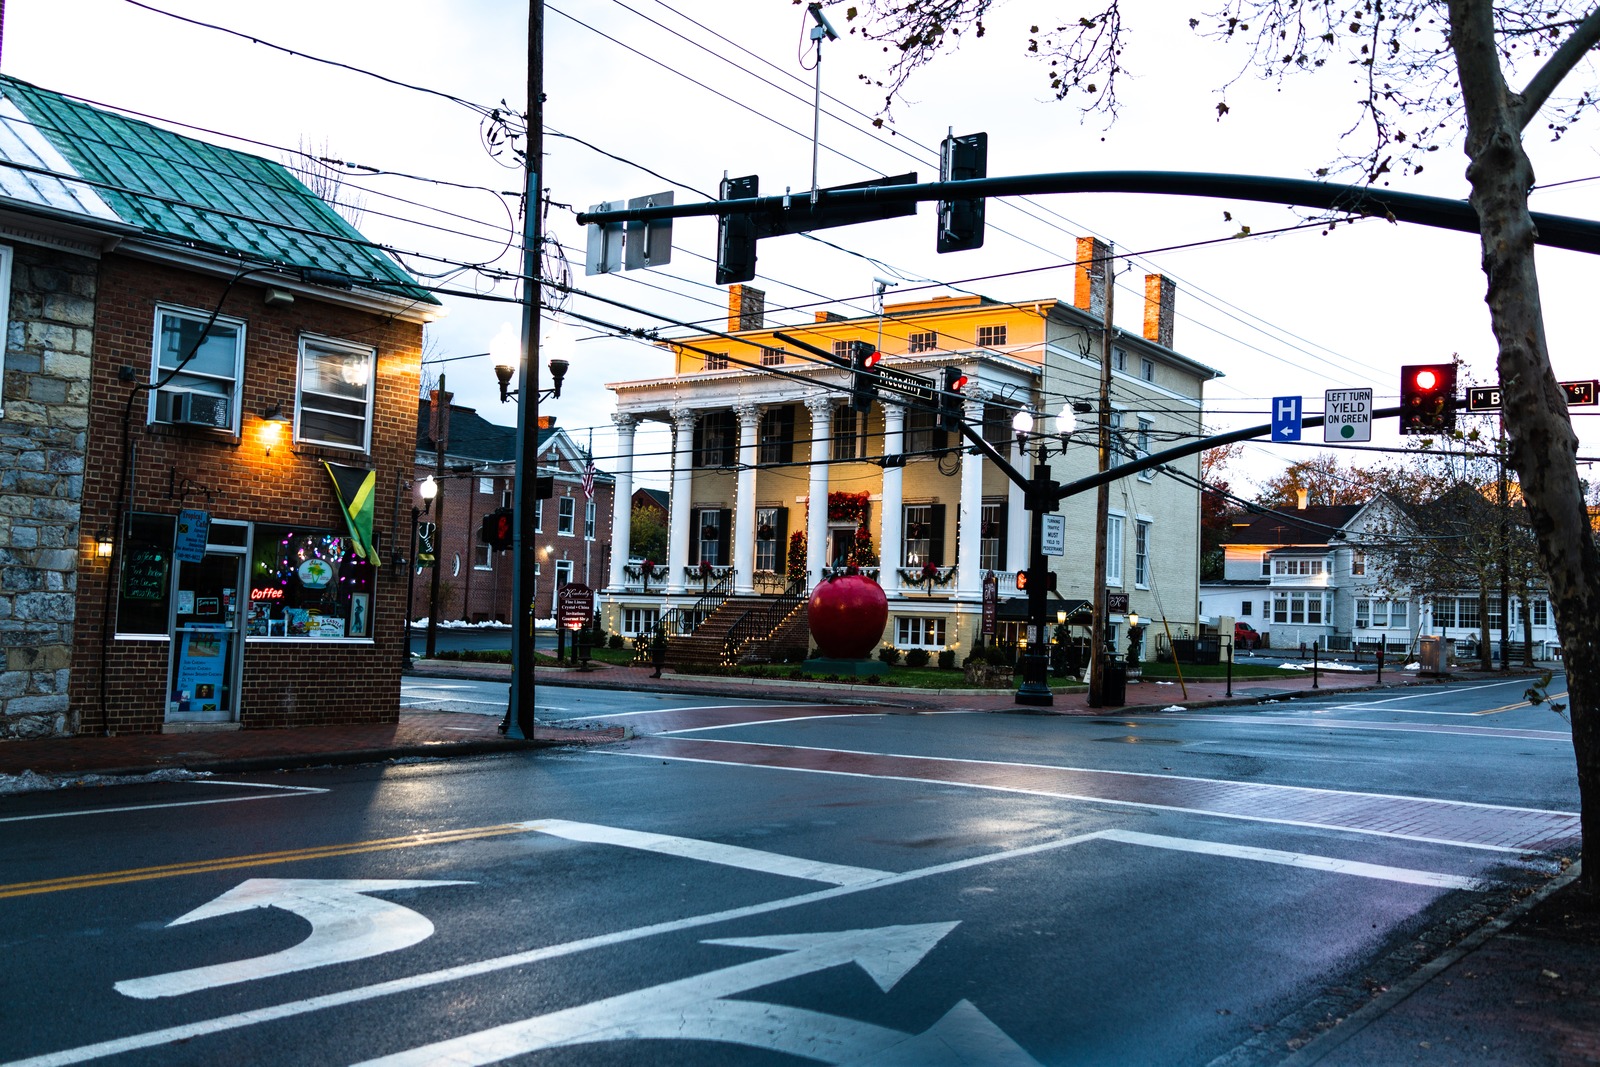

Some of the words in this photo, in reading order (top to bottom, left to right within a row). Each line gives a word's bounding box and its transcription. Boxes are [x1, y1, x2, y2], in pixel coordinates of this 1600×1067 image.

[880, 371, 921, 396] Piccadilly
[1327, 392, 1346, 401] LEFT
[1349, 391, 1370, 400] TURN
[1478, 392, 1484, 400] N
[1278, 399, 1296, 421] H
[1332, 403, 1365, 413] YIELD
[1328, 415, 1337, 423] ON
[1341, 414, 1368, 423] GREEN
[182, 510, 203, 521] Tropical
[419, 522, 436, 553] Shop
[251, 588, 283, 599] Coffee
[560, 589, 592, 598] Kimberly's
